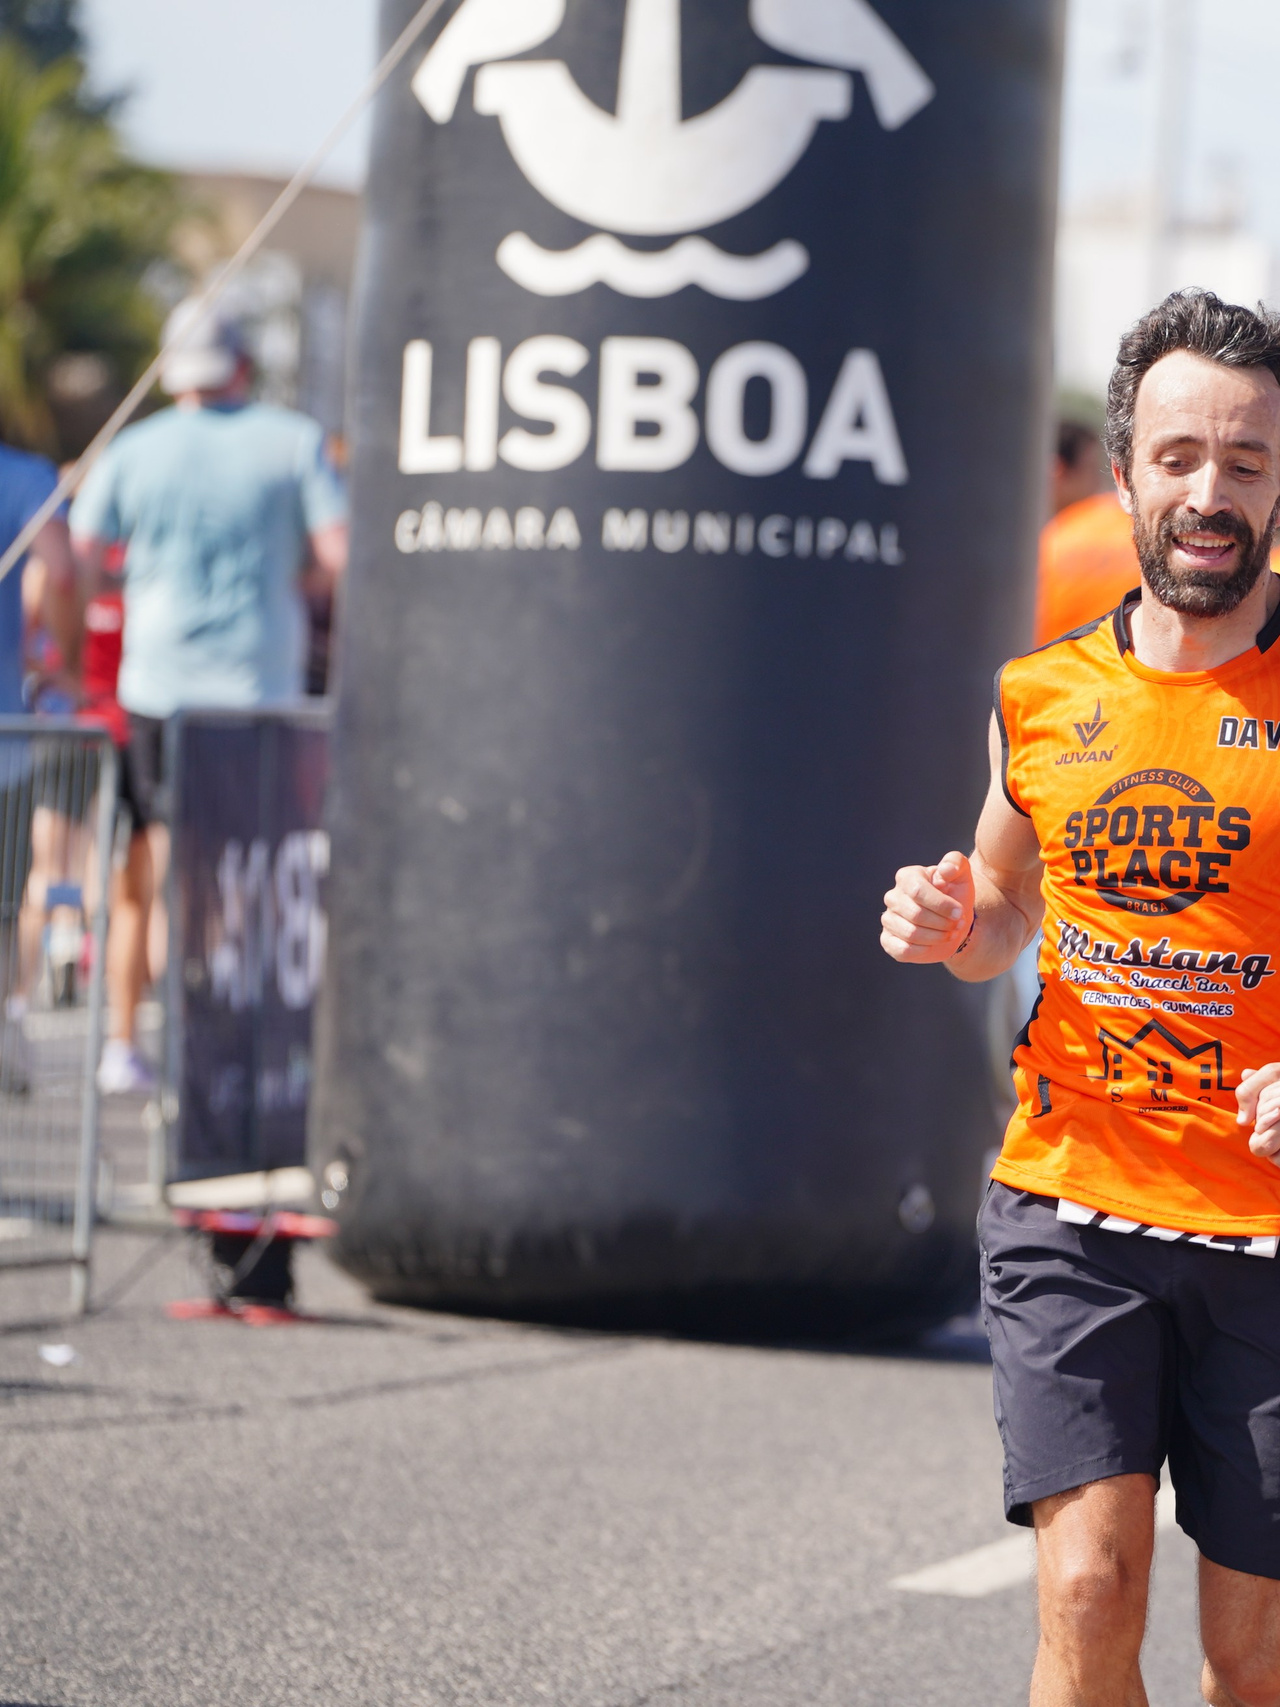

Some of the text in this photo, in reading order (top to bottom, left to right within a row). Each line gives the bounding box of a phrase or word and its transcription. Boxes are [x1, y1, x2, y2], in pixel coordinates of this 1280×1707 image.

[399, 335, 909, 486] LISBOA
[395, 500, 906, 566] CÂMARA MUNICIPAL
[1055, 750, 1115, 766] JUVAN
[1111, 771, 1201, 797] FITNESS CLUB
[1064, 805, 1252, 851] SPORTS
[1072, 849, 1231, 893] PLACE
[1126, 900, 1169, 914] BRAGA
[1057, 918, 1276, 990] Mustang
[1161, 1000, 1235, 1017] GUIMARÃES
[1111, 1086, 1124, 1104] S
